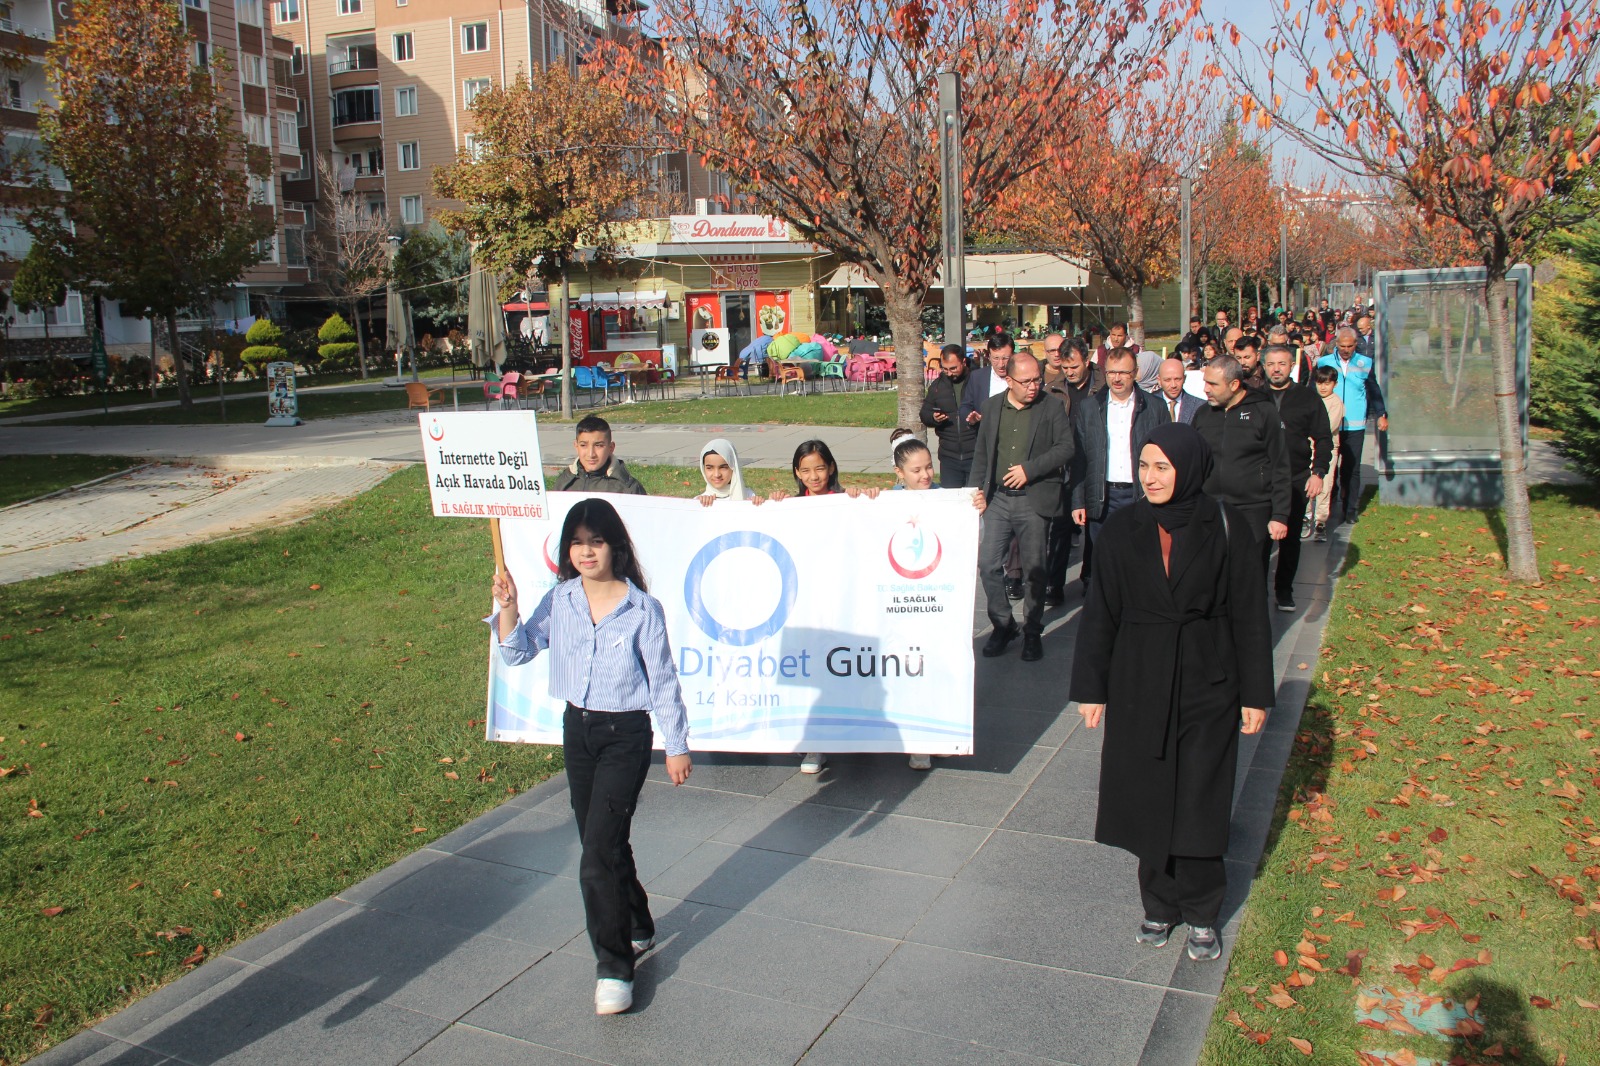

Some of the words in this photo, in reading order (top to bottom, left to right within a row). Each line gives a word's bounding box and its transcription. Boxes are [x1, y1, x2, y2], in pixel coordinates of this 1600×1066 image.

[691, 219, 765, 238] Dondurma
[736, 276, 759, 287] Kafe
[438, 446, 495, 466] İnternette
[498, 451, 529, 470] Değil
[435, 473, 460, 492] Açık
[463, 474, 506, 490] Havada
[508, 475, 541, 496] Dolaş
[441, 501, 451, 514] İL
[452, 501, 485, 515] SAĞLIK
[486, 502, 543, 518] MÜDÜRLÜĞÜ
[893, 595, 901, 604] İL
[903, 594, 937, 603] SAĞLIK
[886, 605, 944, 613] MÜDÜRLÜĞÜ
[679, 645, 811, 687] Diyabet
[826, 646, 925, 677] Günü
[695, 690, 715, 706] 14
[726, 690, 781, 707] Kasım
